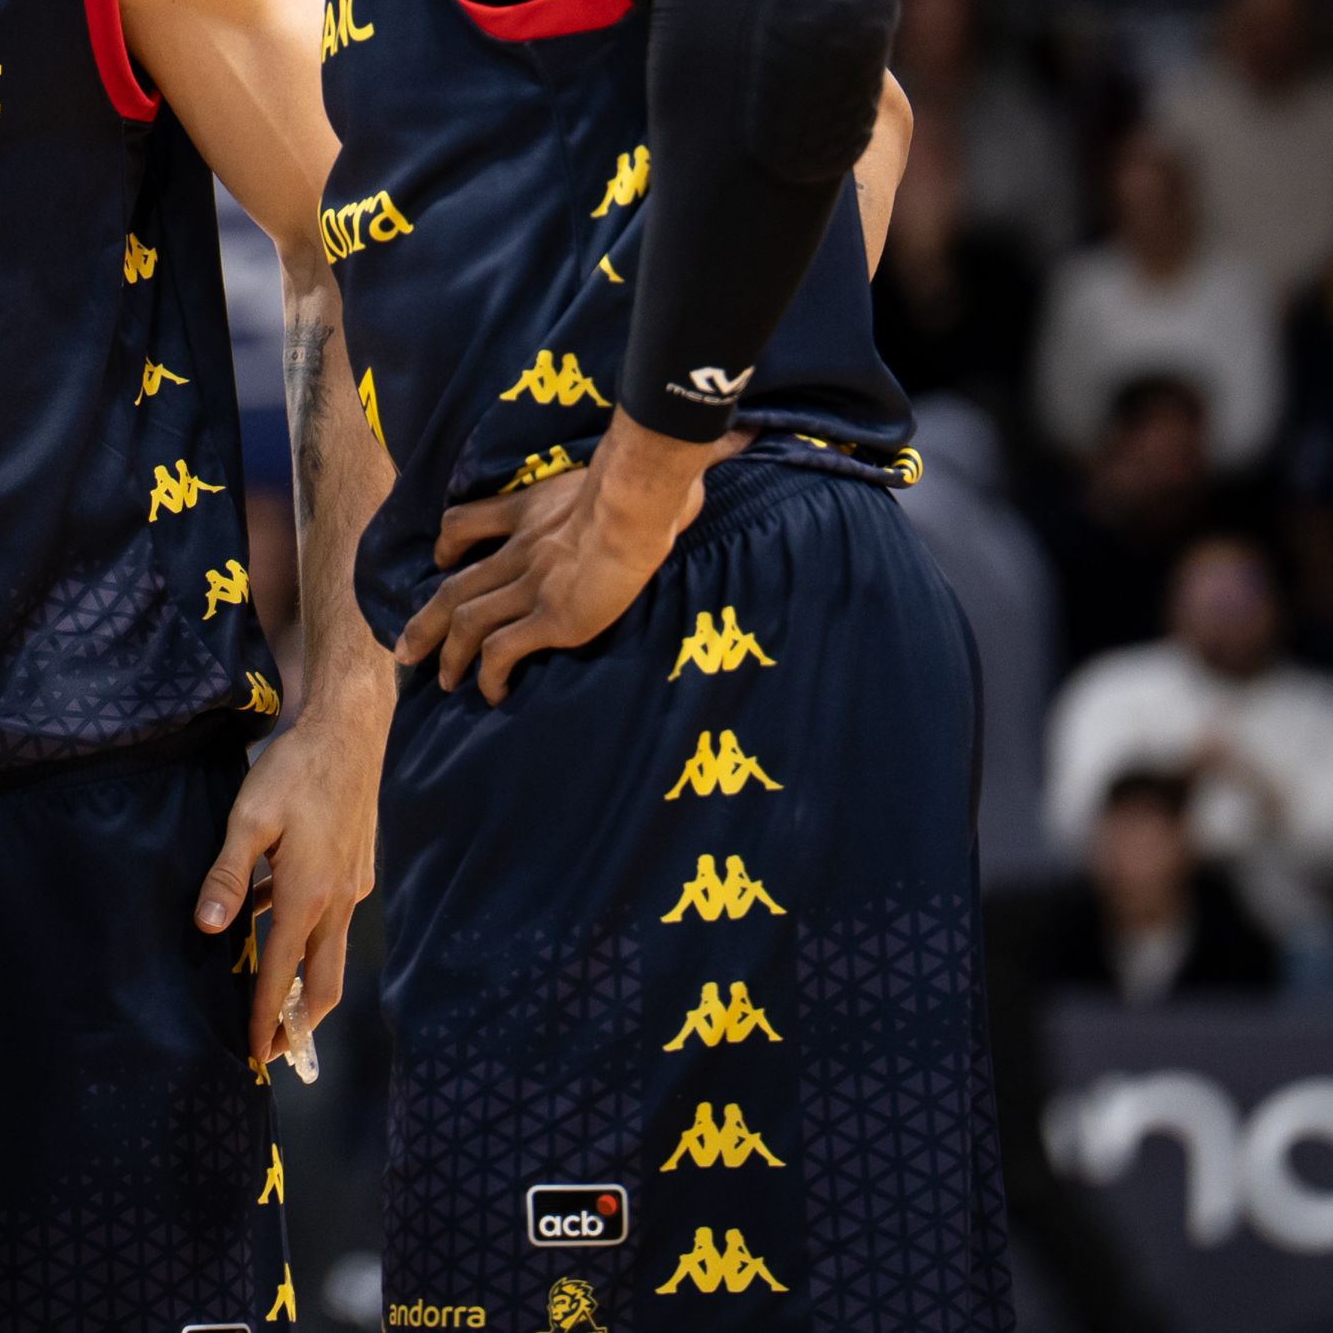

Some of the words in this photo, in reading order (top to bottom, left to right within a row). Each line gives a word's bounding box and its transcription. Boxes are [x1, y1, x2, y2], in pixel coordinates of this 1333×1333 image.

[319, 191, 414, 264] orra
[539, 1210, 604, 1237] acb
[389, 1298, 486, 1328] andorra
